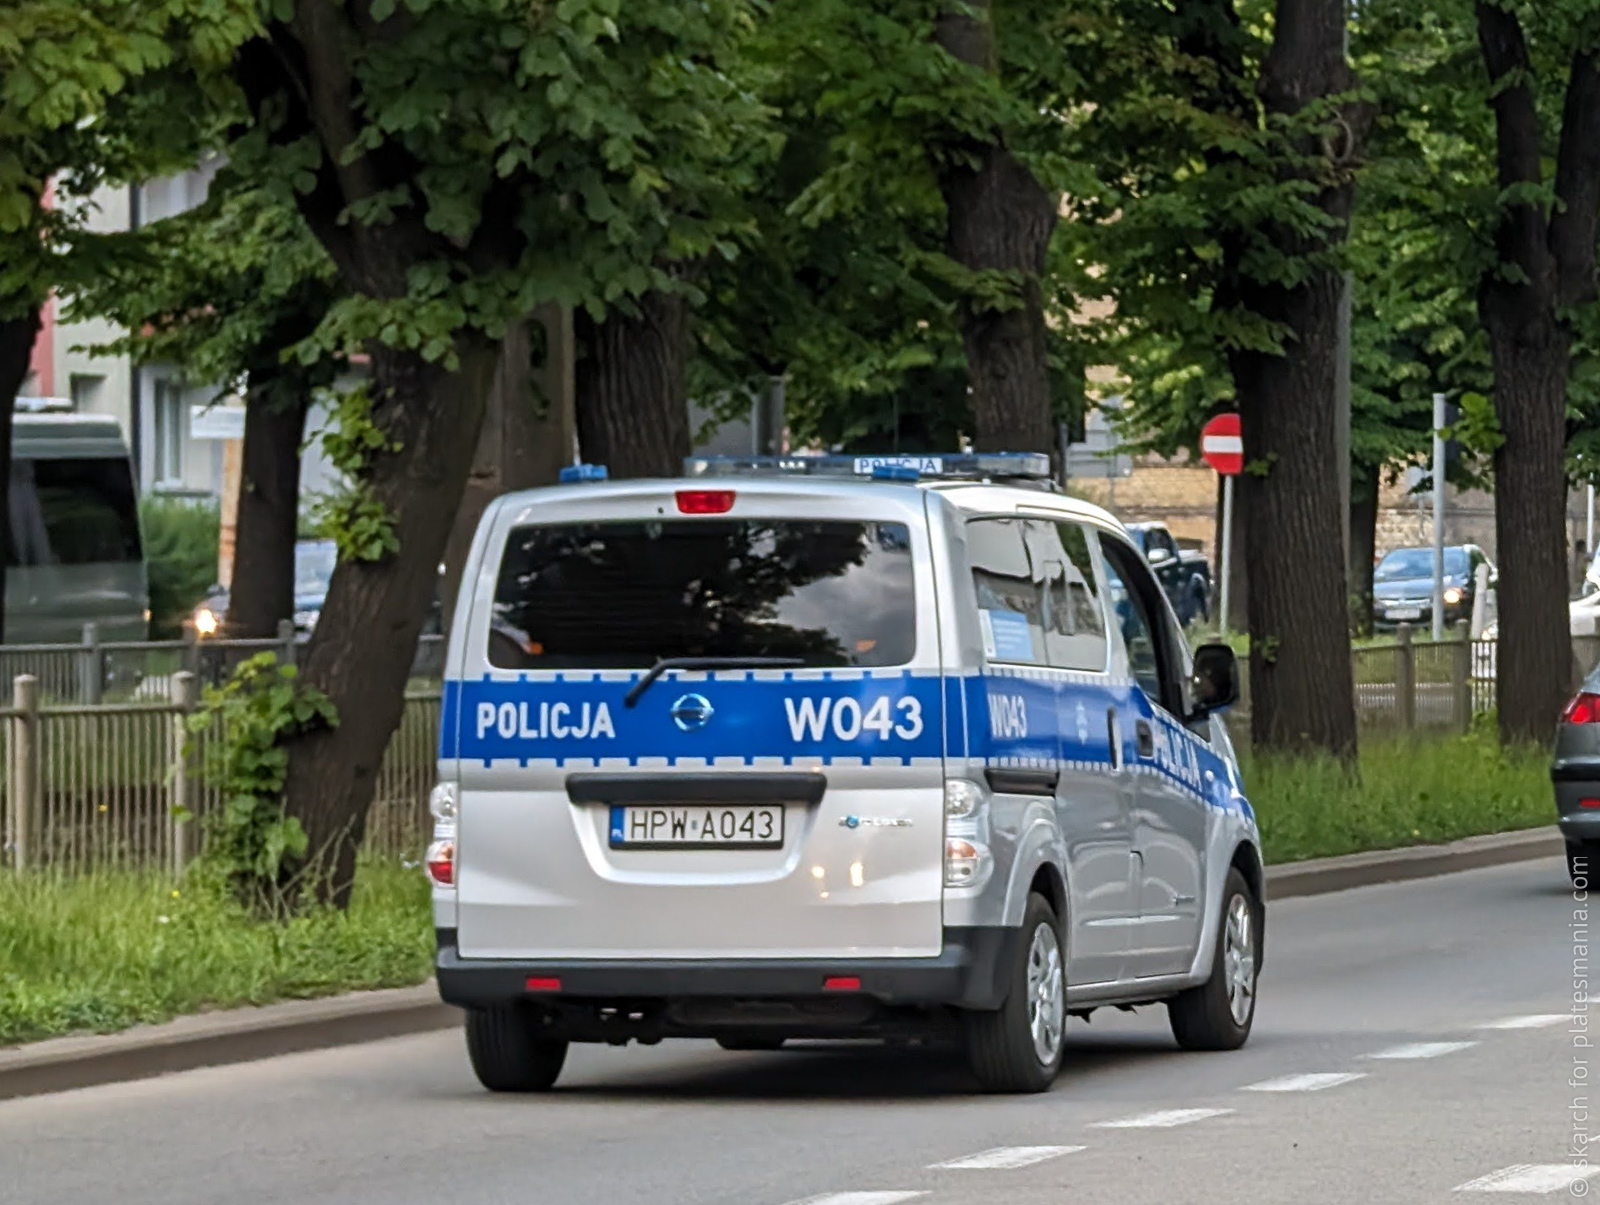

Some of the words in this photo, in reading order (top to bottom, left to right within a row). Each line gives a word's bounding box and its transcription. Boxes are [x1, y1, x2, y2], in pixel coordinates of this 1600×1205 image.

[477, 702, 616, 739] POLICJA
[784, 696, 924, 742] W043
[987, 694, 1027, 738] W043
[631, 810, 687, 839] HPW
[701, 810, 773, 839] A043
